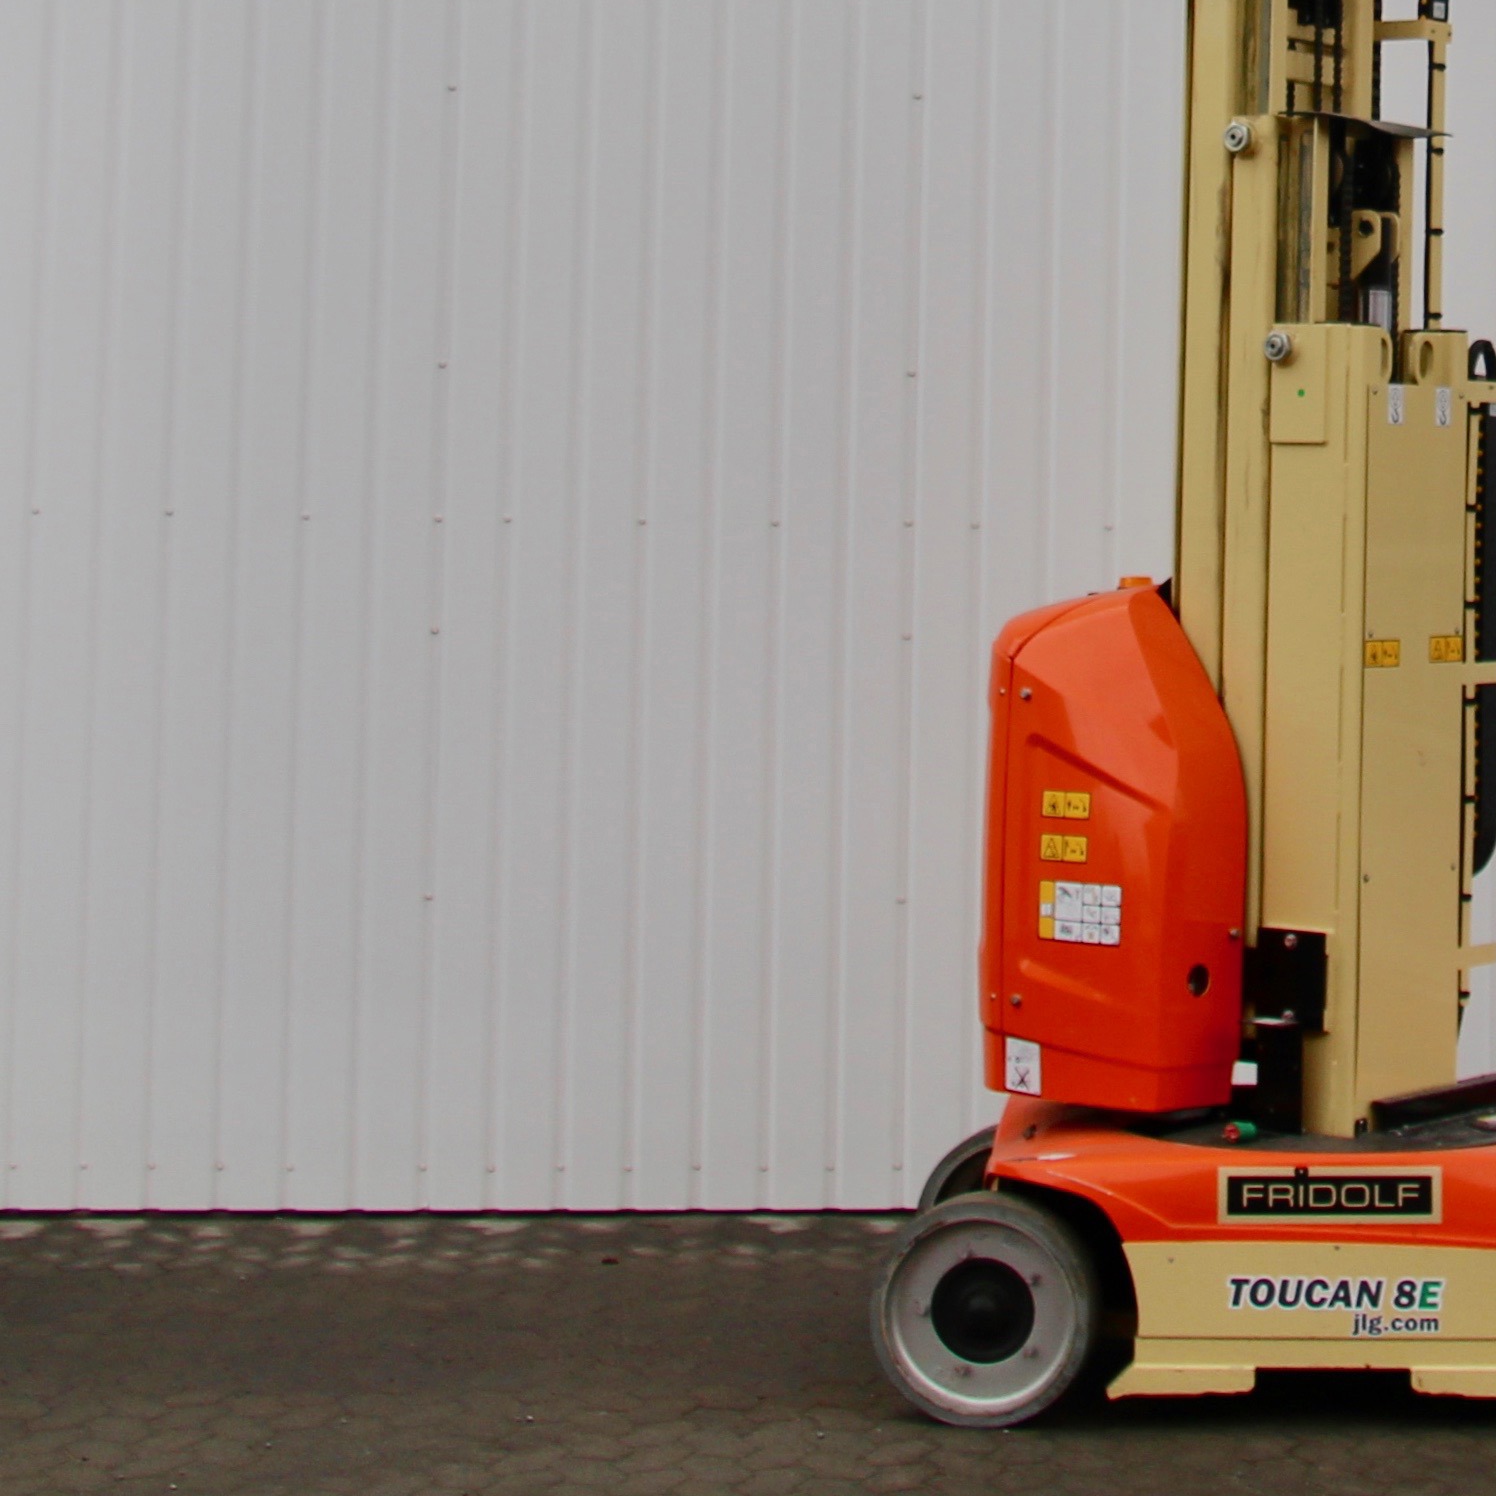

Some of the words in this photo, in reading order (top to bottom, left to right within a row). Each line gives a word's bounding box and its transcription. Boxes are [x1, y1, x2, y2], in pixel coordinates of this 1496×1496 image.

[1242, 1169, 1421, 1208] FRIDOLF
[1229, 1277, 1384, 1310] TOUCAN
[1392, 1279, 1444, 1311] 8E
[1352, 1313, 1440, 1337] jlg.com
